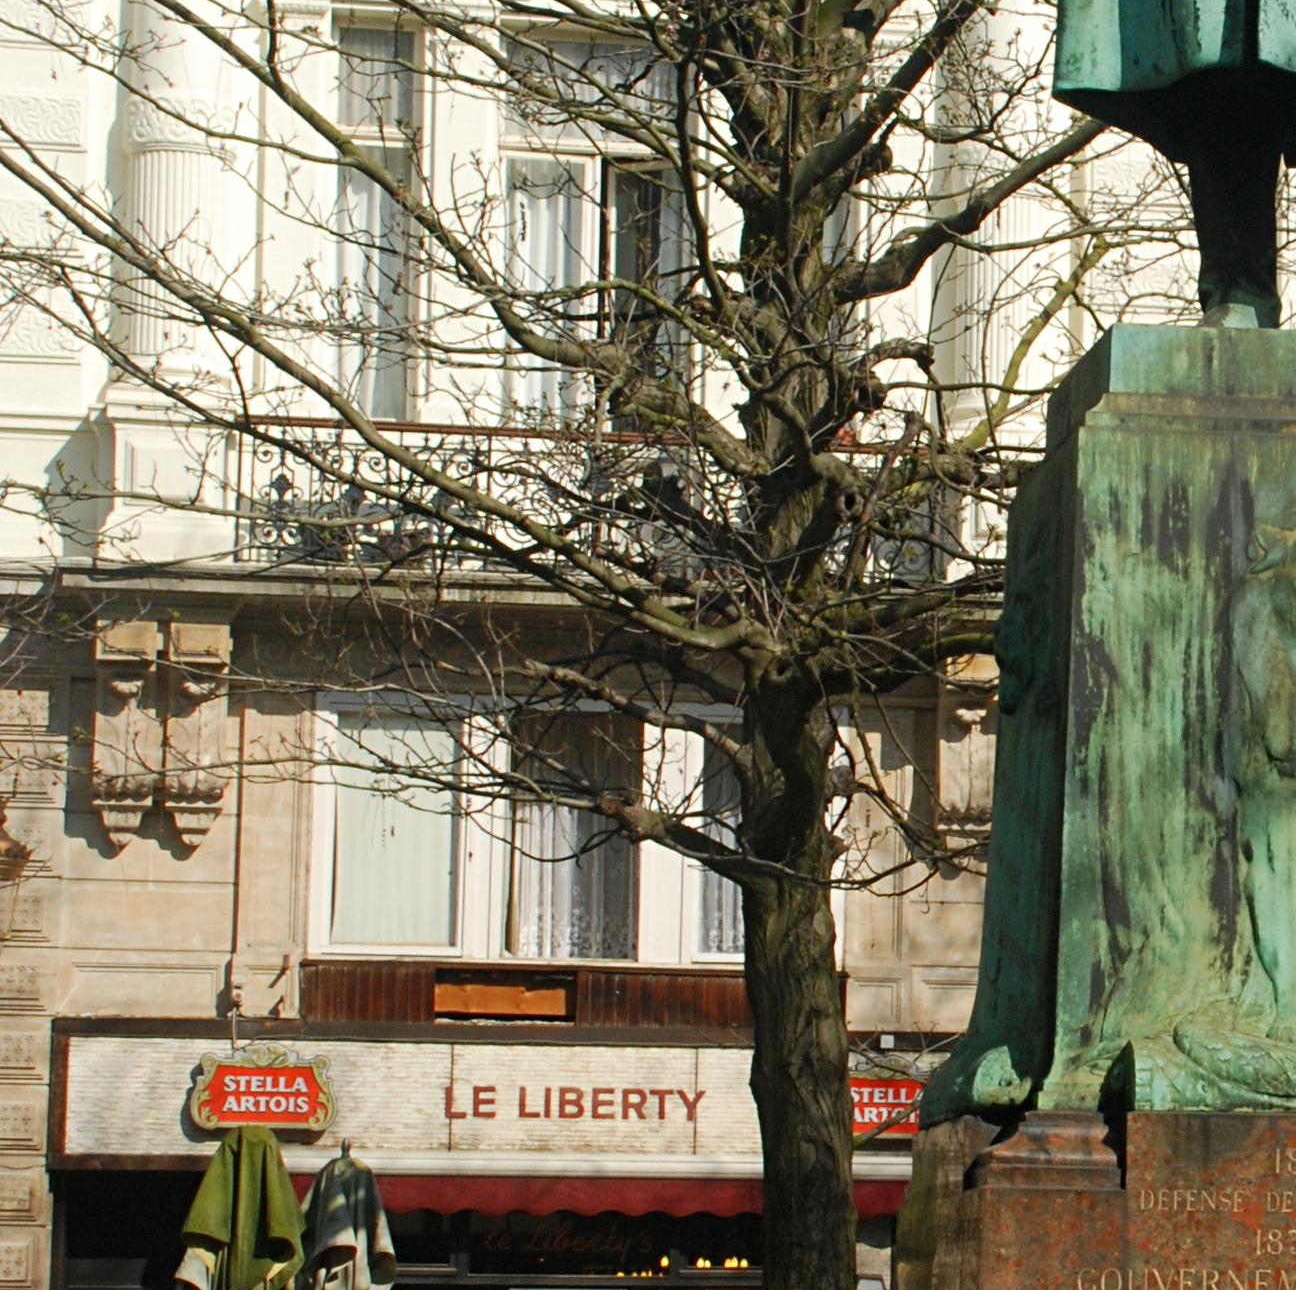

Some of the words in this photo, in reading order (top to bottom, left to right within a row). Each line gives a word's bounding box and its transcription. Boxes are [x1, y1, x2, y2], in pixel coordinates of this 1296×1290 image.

[223, 1075, 309, 1093] STELLA
[222, 1096, 310, 1113] ARTOIS
[445, 1086, 496, 1119] LE
[518, 1086, 706, 1121] LIBERTY
[1140, 1189, 1245, 1211] DEFENSE
